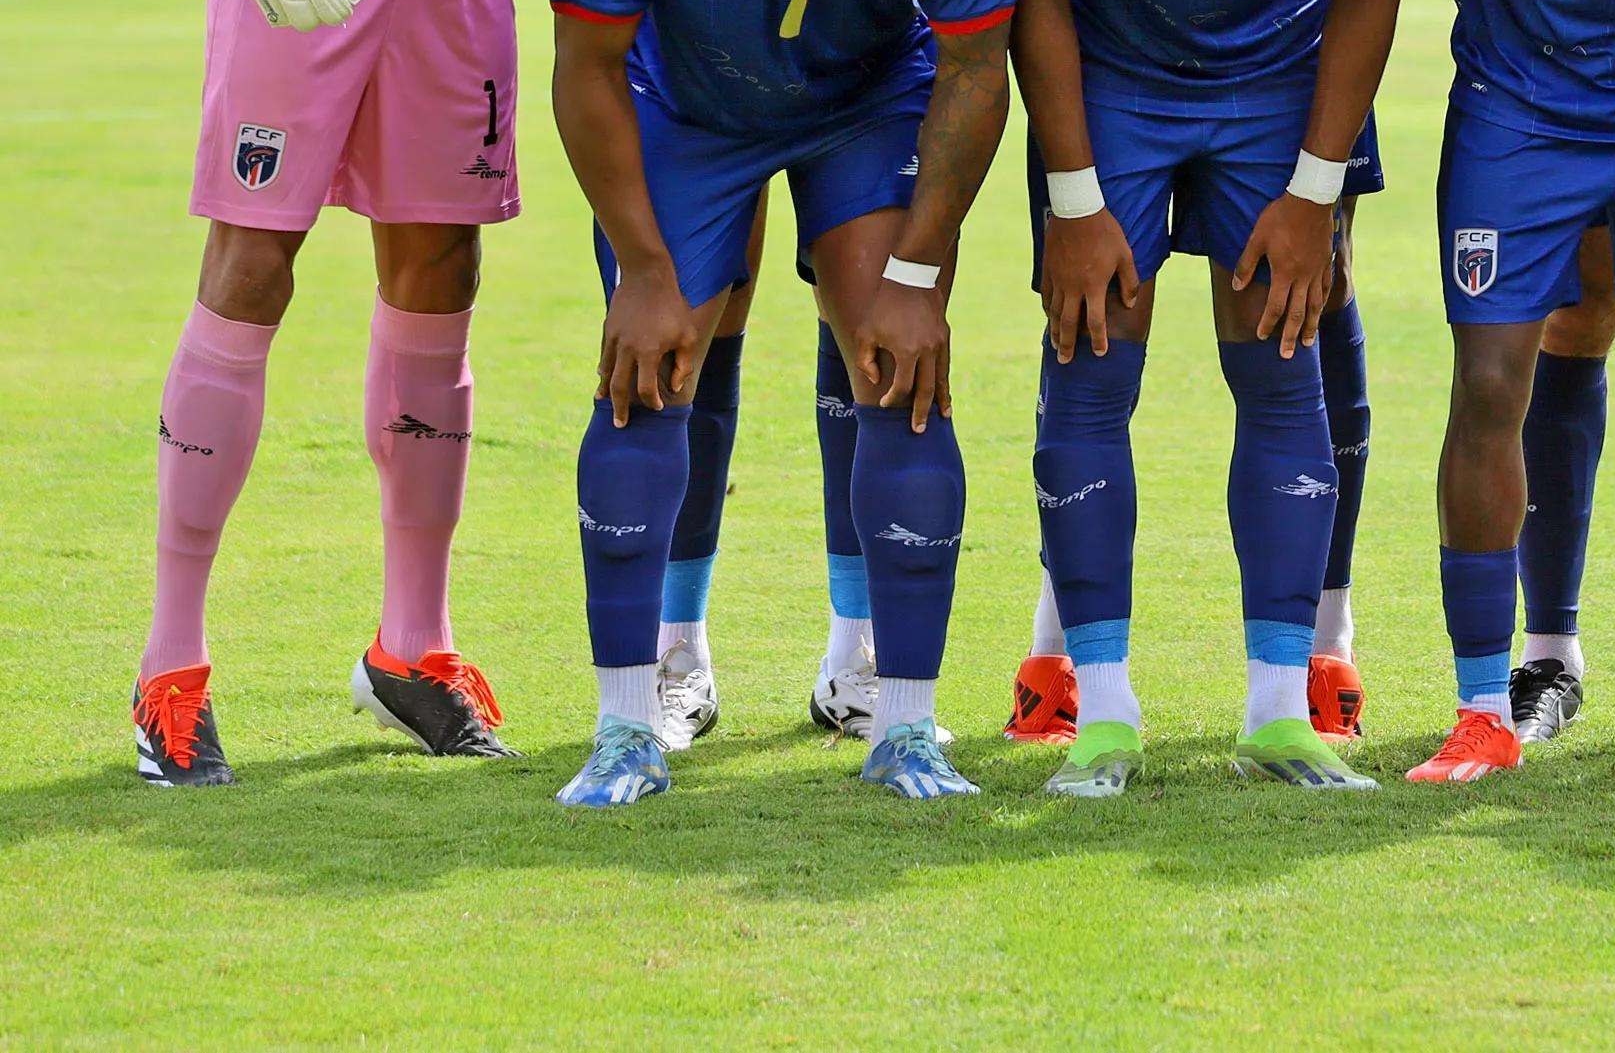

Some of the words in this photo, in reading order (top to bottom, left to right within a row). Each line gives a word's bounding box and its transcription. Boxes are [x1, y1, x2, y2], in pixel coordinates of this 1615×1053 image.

[483, 79, 498, 147] 1
[240, 126, 283, 143] FCF
[1347, 156, 1370, 169] mpo
[480, 168, 511, 181] temp
[1457, 232, 1494, 243] FCF
[1040, 479, 1107, 509] tempo
[583, 519, 648, 537] tempo
